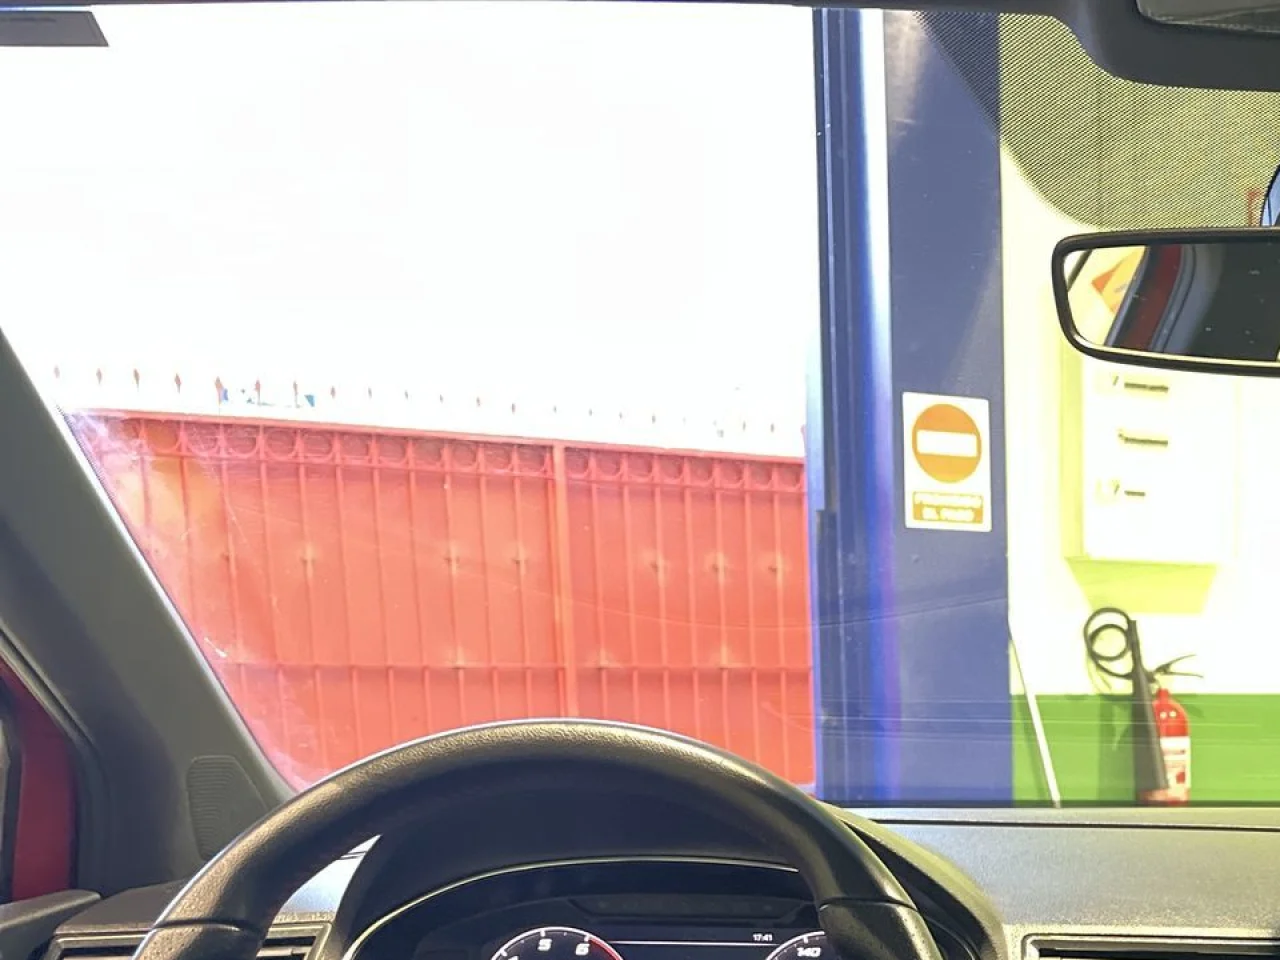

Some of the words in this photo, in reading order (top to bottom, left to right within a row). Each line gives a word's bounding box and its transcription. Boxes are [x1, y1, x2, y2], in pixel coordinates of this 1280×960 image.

[538, 939, 552, 951] 5
[575, 943, 590, 956] 6
[797, 947, 821, 957] 140
